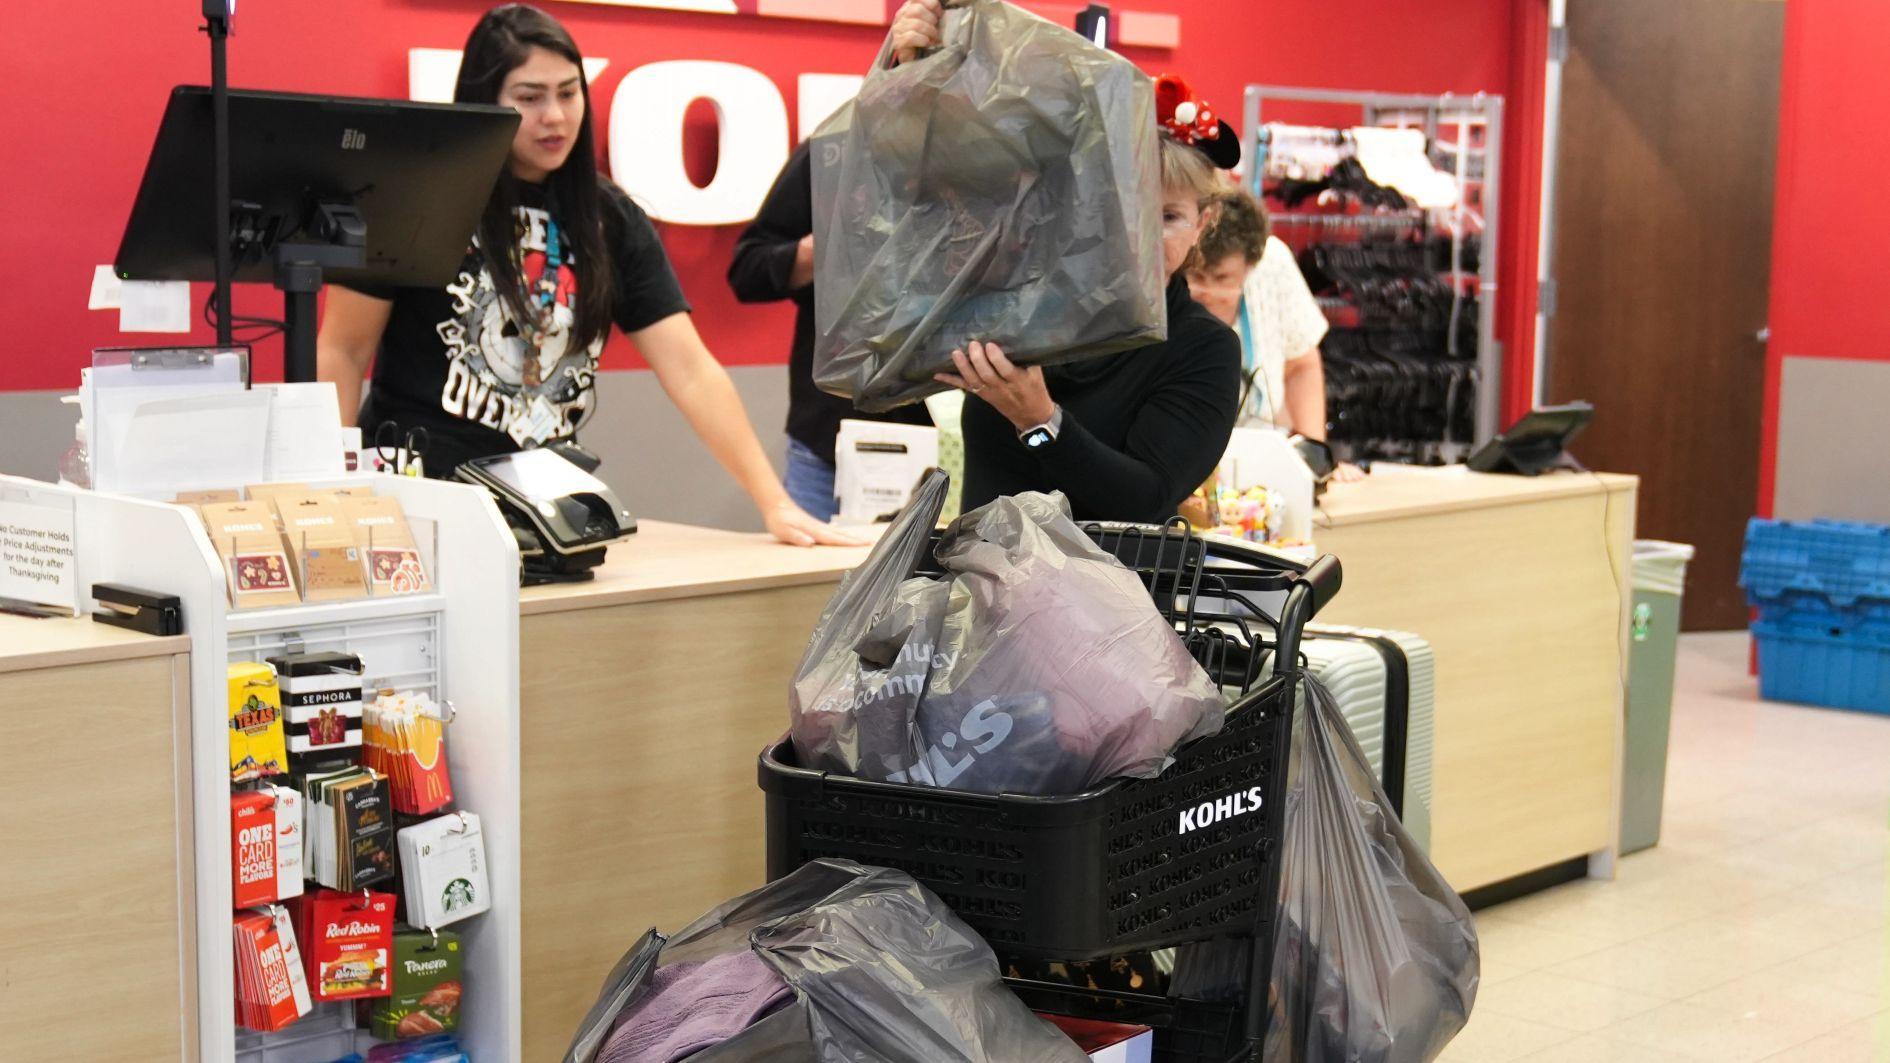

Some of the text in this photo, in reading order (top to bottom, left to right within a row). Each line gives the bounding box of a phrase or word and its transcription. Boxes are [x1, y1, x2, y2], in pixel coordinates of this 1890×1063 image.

[9, 525, 46, 538] Customer
[47, 531, 70, 542] Holds
[3, 537, 74, 556] Price Adjustments
[3, 552, 64, 569] for the day after
[9, 566, 59, 584] Thanksgiving
[302, 691, 352, 704] SEPHORA
[236, 707, 275, 729] TEXAS
[1179, 785, 1263, 835] KOHL'S
[239, 823, 273, 846] ONE
[239, 841, 273, 866] CARD
[240, 860, 273, 876] MORE
[240, 870, 274, 885] FLAVORS
[326, 921, 381, 938] Red Robin
[260, 943, 283, 968] ONE
[263, 960, 286, 988] CARD
[404, 958, 447, 974] Panera
[267, 976, 290, 1001] MORE
